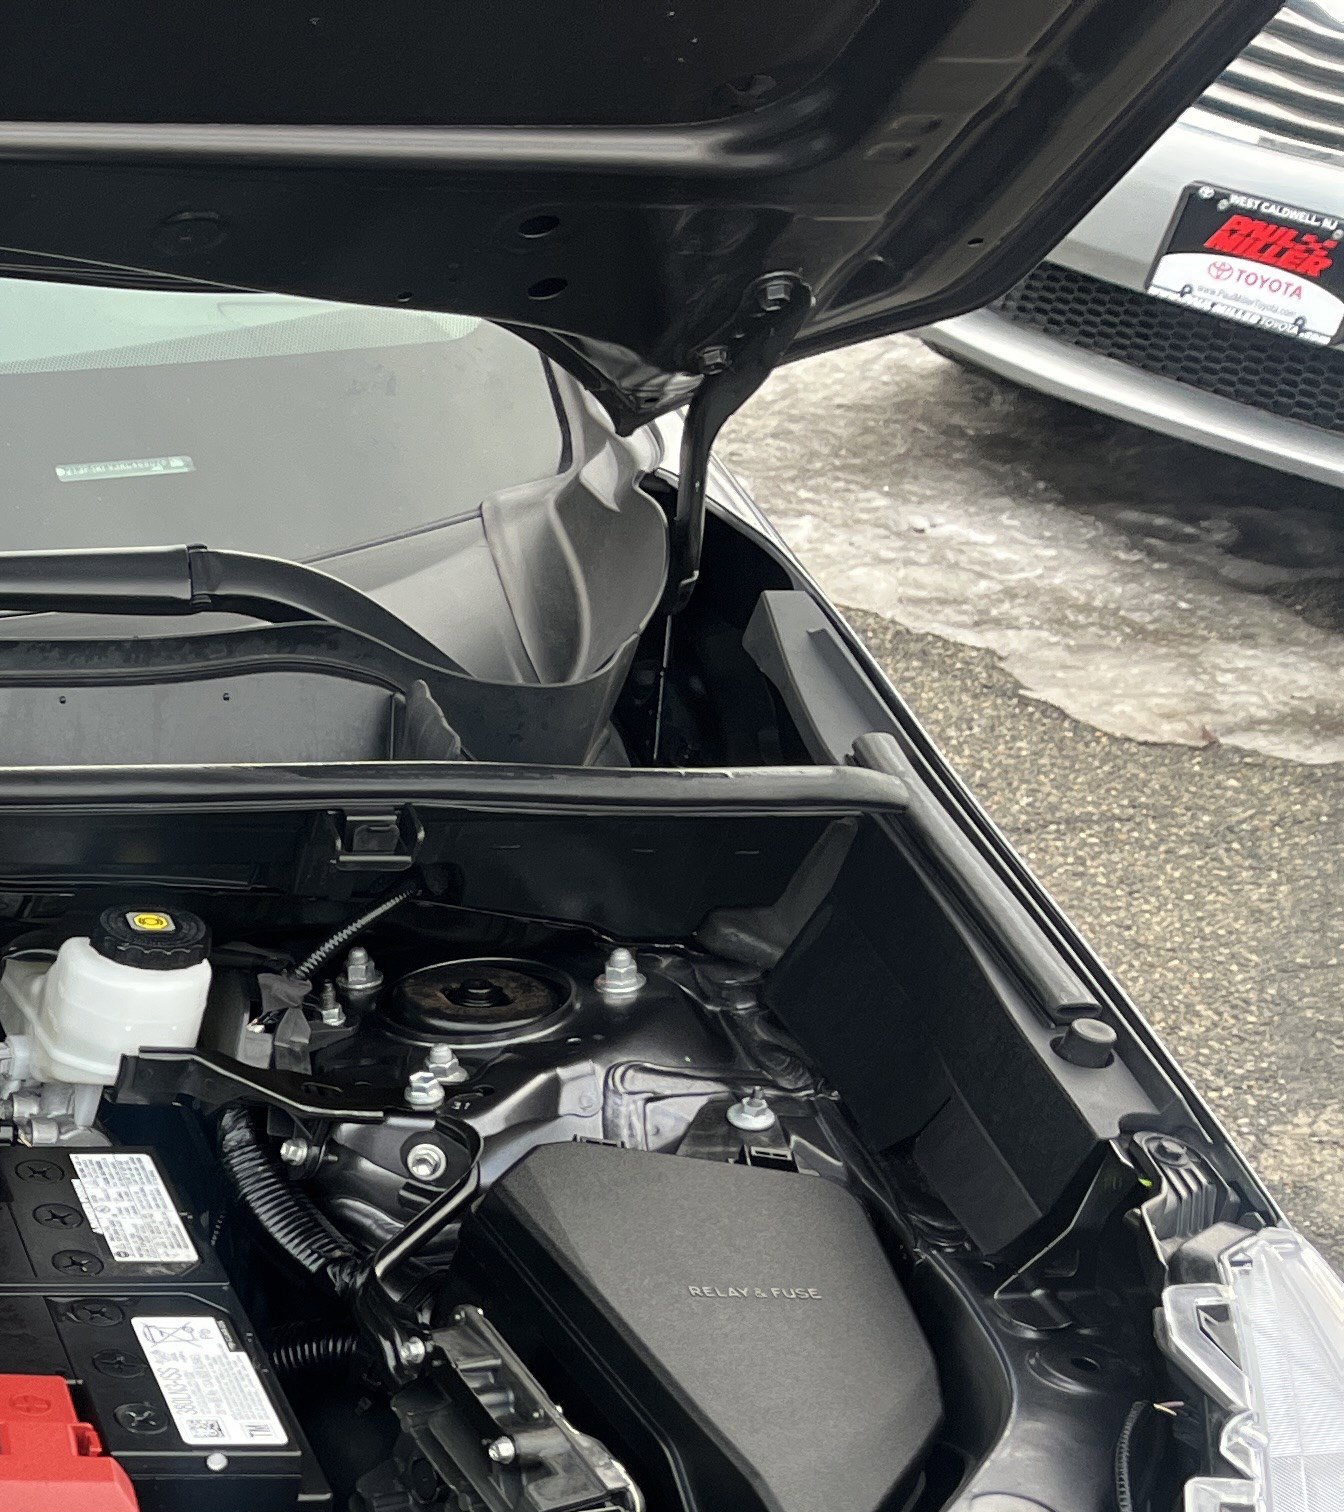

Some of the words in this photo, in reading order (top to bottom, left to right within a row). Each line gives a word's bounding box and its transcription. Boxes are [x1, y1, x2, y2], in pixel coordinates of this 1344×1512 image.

[1229, 194, 1262, 210] WEST
[1321, 215, 1338, 230] NJ
[1218, 214, 1299, 246] PAUL
[1203, 230, 1333, 277] MILLER
[1235, 268, 1303, 300] TOYOTA
[688, 1285, 749, 1298] RELAY
[753, 1287, 767, 1298] &
[770, 1287, 822, 1300] FUSE
